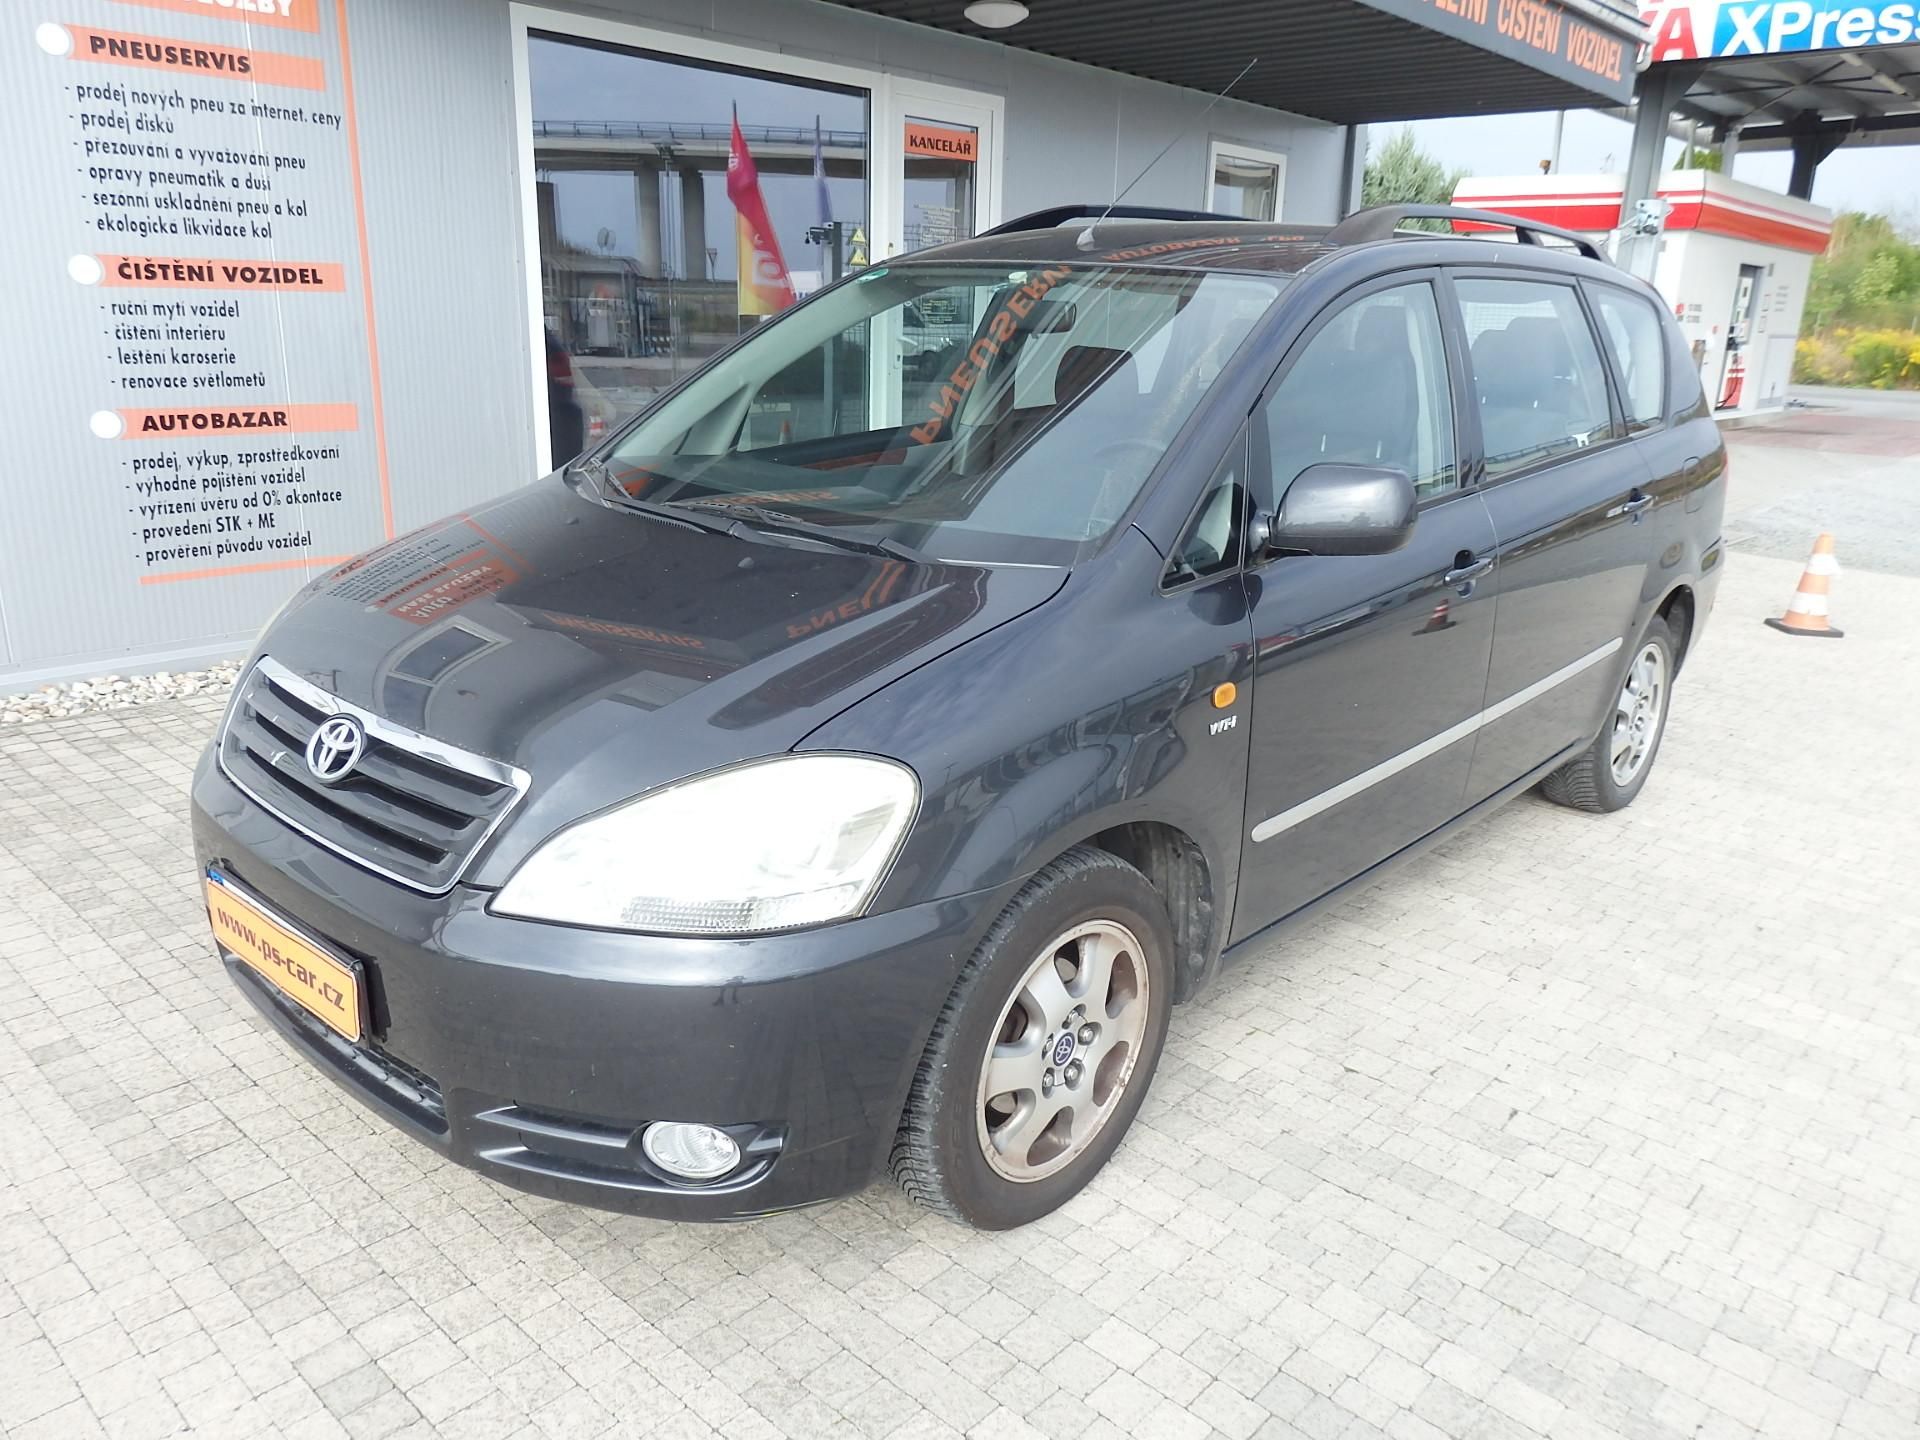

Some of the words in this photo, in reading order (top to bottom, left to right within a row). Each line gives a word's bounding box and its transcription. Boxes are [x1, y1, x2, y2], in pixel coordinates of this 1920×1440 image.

[1719, 2, 1920, 57] XPres
[89, 35, 251, 74] PNEUSERVIS
[1567, 21, 1622, 82] VOZIDEL
[76, 81, 127, 108] prodej
[131, 89, 184, 111] nových
[190, 97, 224, 114] pneu
[229, 102, 246, 115] za
[312, 112, 341, 130] ceny
[81, 109, 130, 135] prodej
[910, 135, 971, 155] KANCELÁŘ
[175, 147, 183, 160] a
[274, 155, 306, 172] pneu
[89, 166, 142, 187] opravy
[149, 169, 225, 189] pneumatik
[232, 177, 239, 188] a
[237, 202, 269, 218] pneu
[274, 204, 282, 215] a
[286, 198, 307, 216] kol
[183, 217, 246, 238] likvidace
[251, 220, 272, 239] kol
[118, 257, 214, 282] ČIŠTĚNÍ
[222, 266, 323, 285] VOZIDEL
[190, 299, 240, 318] vozidel
[118, 347, 166, 365] leštění
[171, 347, 236, 365] karoserie
[122, 376, 187, 389] renovace
[193, 370, 266, 389] světlometů
[142, 411, 288, 432] AUTOBAZAR
[133, 452, 181, 475] prodej,
[261, 466, 306, 485] vozidel
[243, 493, 258, 509] od
[262, 489, 282, 507] 0%
[286, 488, 342, 506] akontace
[143, 521, 212, 544] provedení
[216, 515, 242, 533] STK
[258, 513, 276, 529] ME
[216, 537, 263, 558] původu
[267, 530, 312, 549] vozidel
[217, 907, 345, 1012] www.ps-car.cz
